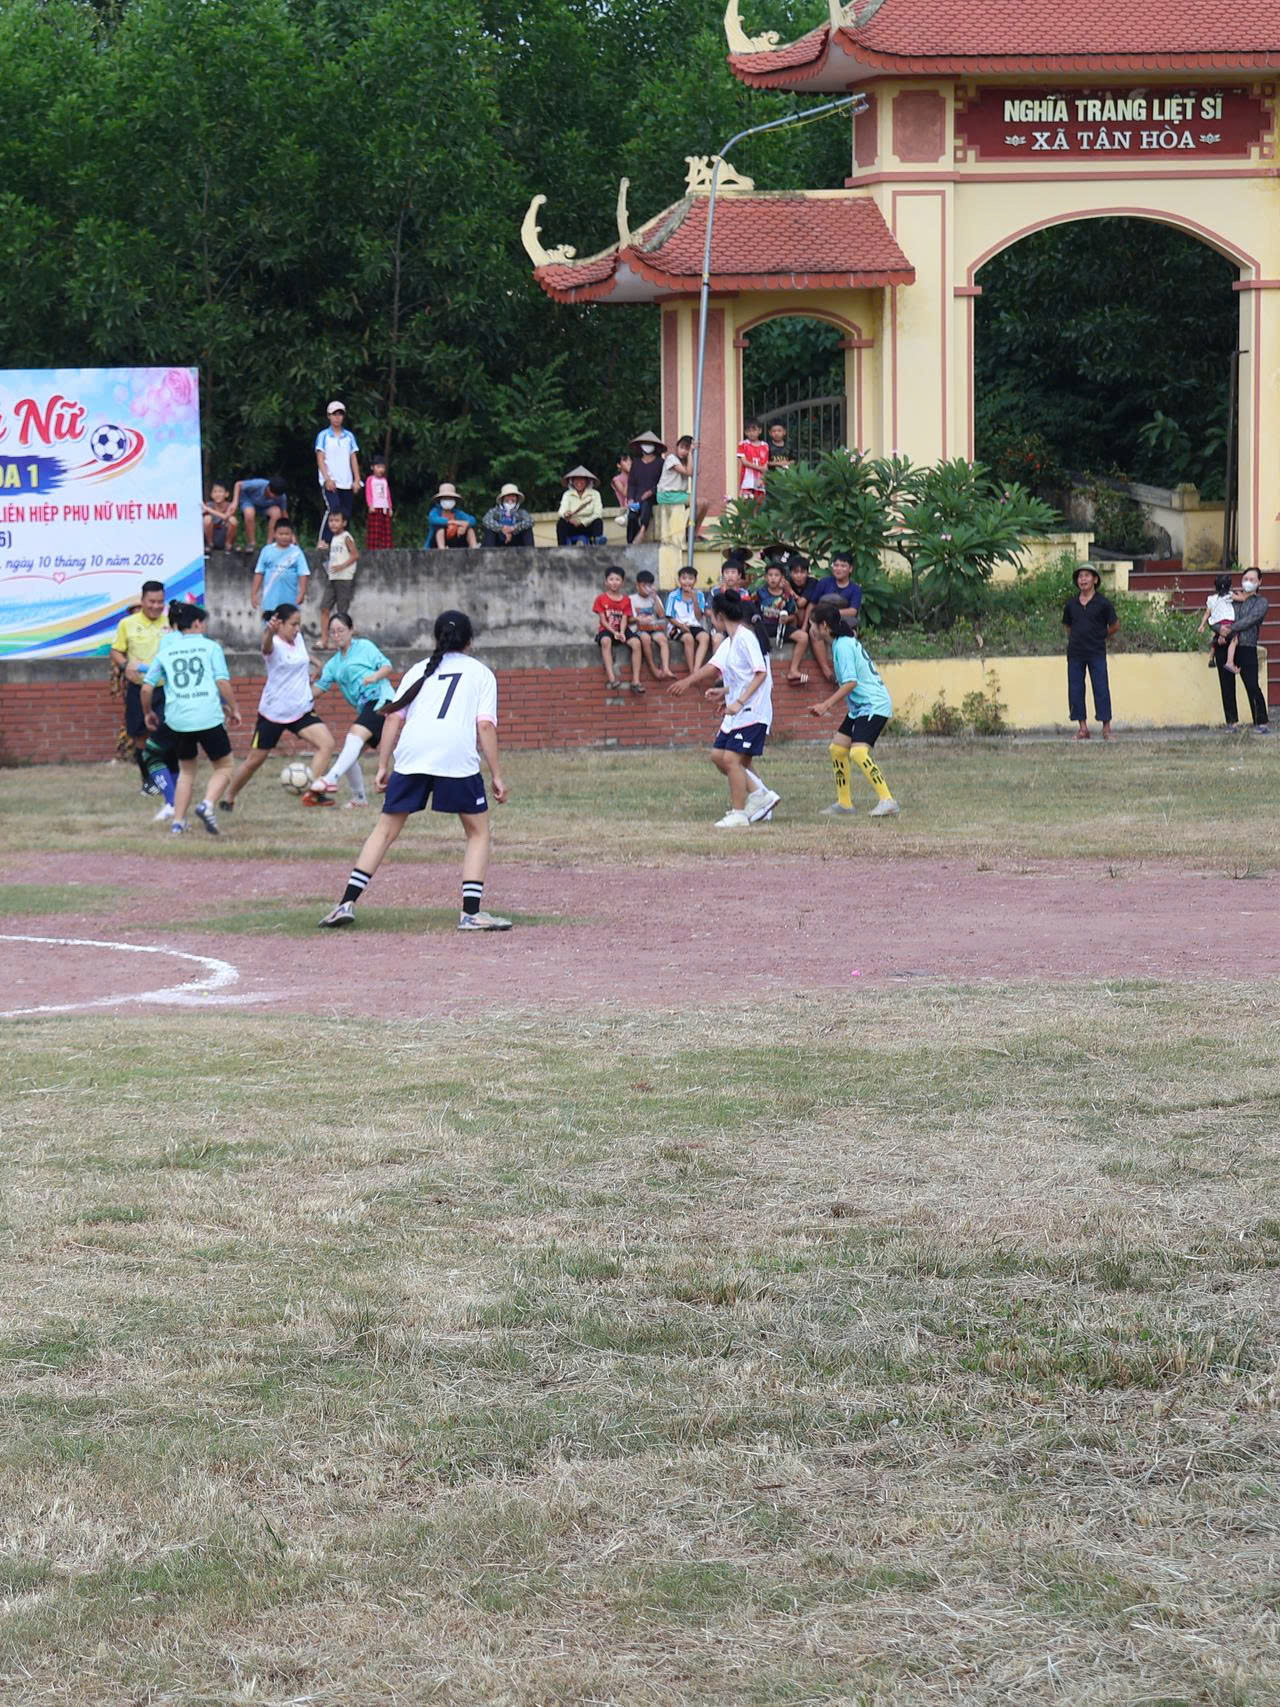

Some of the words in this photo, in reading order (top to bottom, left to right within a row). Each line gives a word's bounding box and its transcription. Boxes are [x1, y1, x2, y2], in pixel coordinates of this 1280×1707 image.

[1004, 95, 1069, 122] NGHĨA
[1075, 99, 1147, 121] TRANG
[1152, 94, 1195, 124] LIỆT
[1200, 93, 1223, 120] SĨ
[1031, 128, 1070, 150] XÃ
[1077, 126, 1132, 150] TÂN
[1140, 124, 1196, 149] HÒA
[14, 395, 86, 445] Nữ
[27, 463, 40, 488] 1
[29, 502, 59, 525] HIỆP
[63, 505, 90, 525] PHỤ
[94, 501, 114, 521] NỮ
[115, 500, 143, 523] VIỆT
[147, 503, 178, 520] NAM
[5, 558, 35, 573] ngày
[38, 555, 52, 568] 10
[55, 554, 87, 571] tháng
[90, 554, 104, 566] 10
[106, 554, 130, 566] năm
[133, 553, 164, 567] 2026
[172, 656, 205, 688] 89
[437, 672, 463, 719] 7
